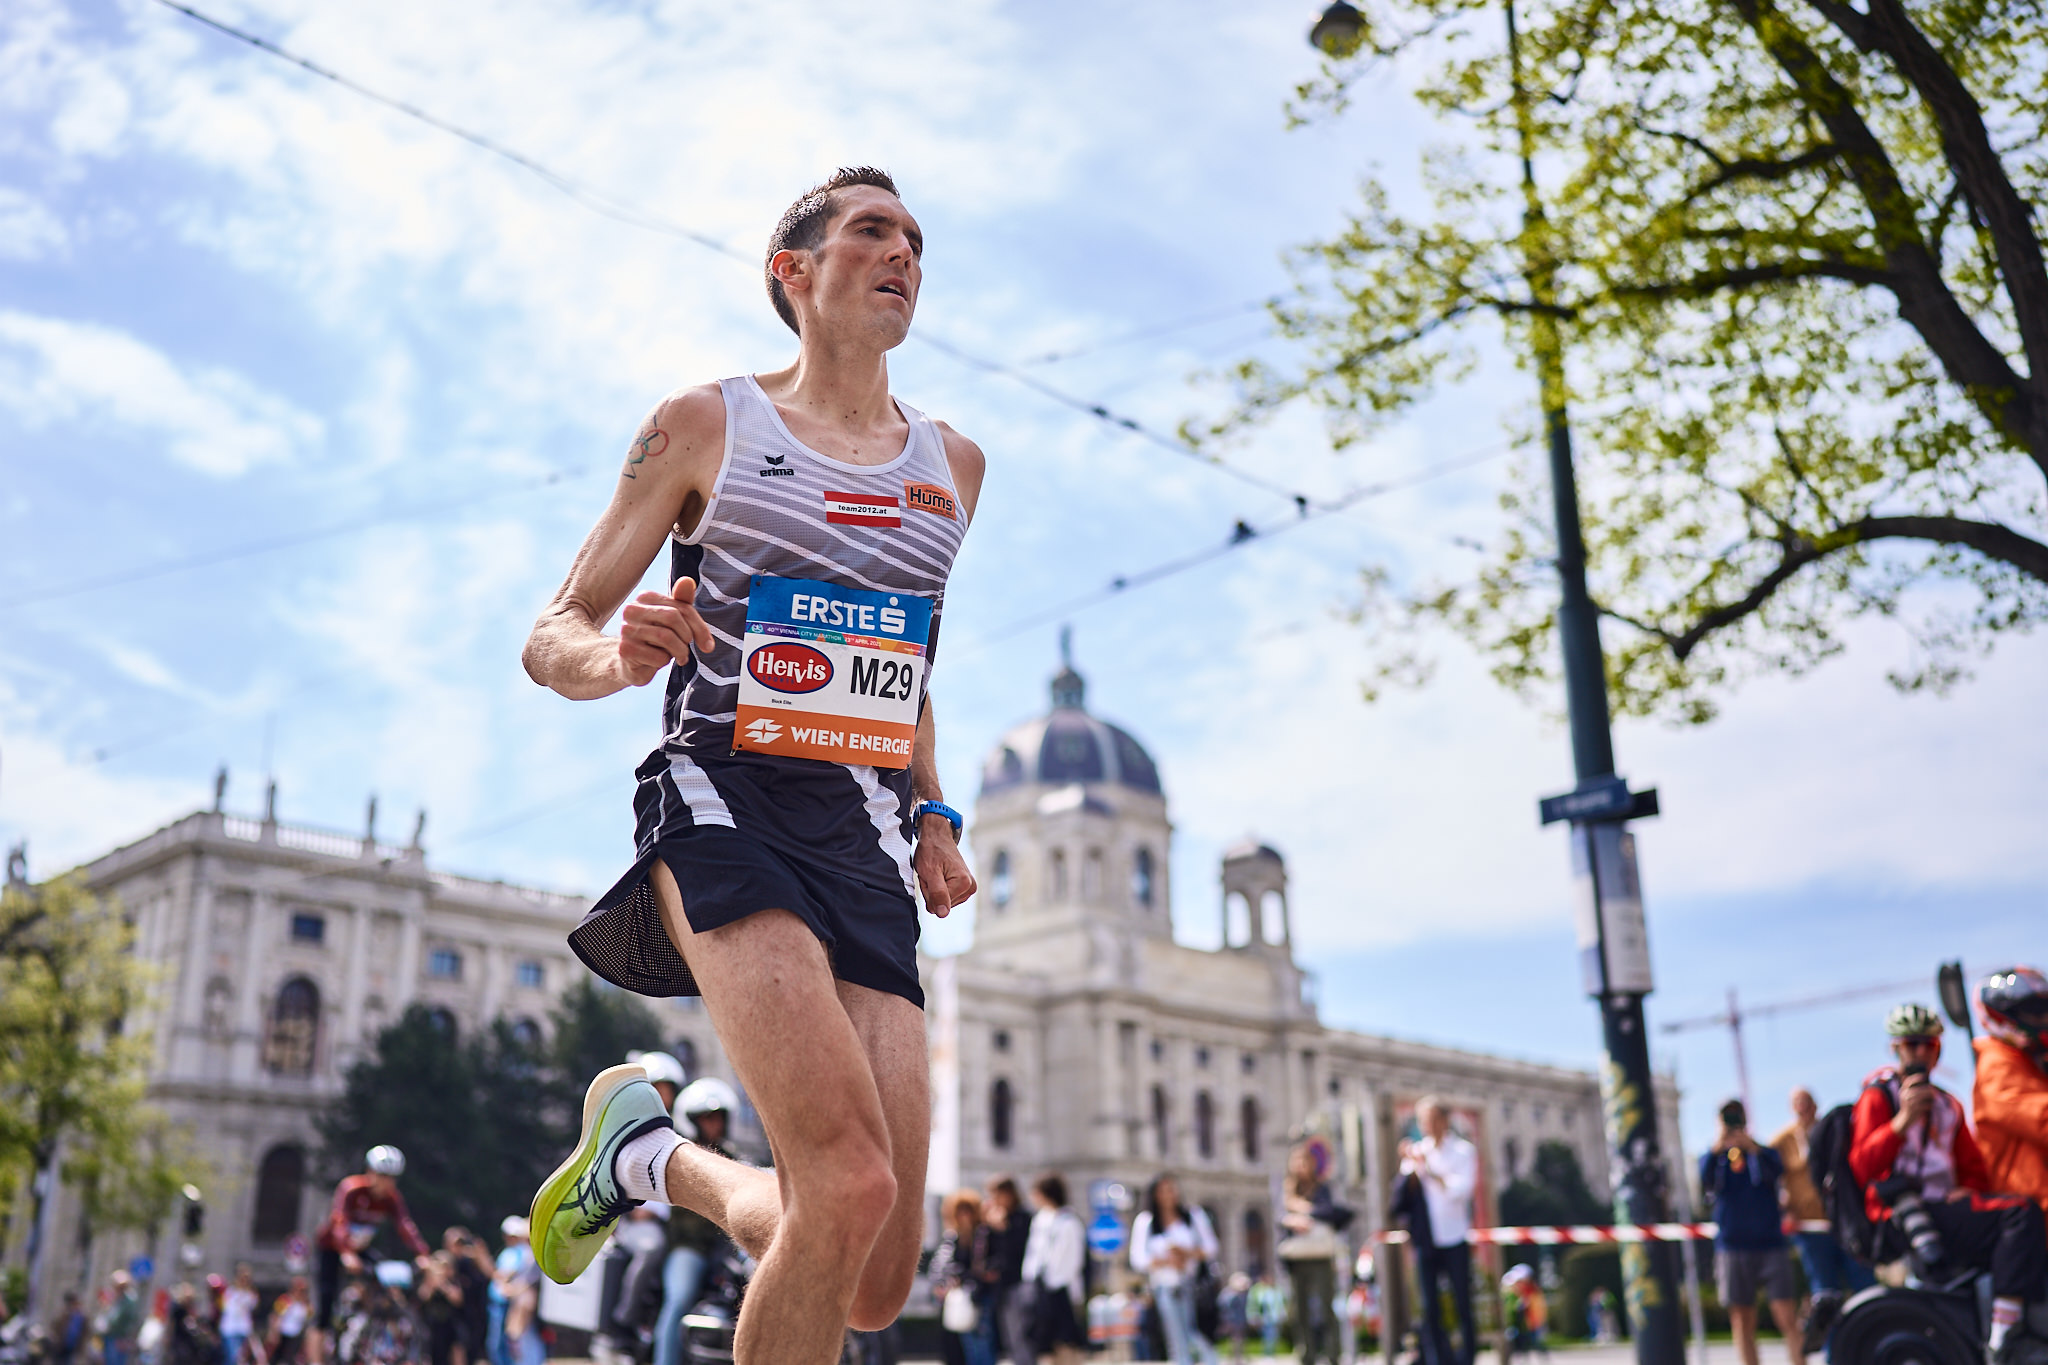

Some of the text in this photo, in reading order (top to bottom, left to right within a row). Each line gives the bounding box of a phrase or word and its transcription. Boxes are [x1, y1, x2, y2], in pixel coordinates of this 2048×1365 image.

[760, 467, 794, 477] erima
[838, 504, 887, 515] team2012.at
[910, 486, 953, 512] Hums
[790, 593, 875, 631] ERSTE
[780, 628, 800, 636] VIENNA
[813, 632, 842, 641] MARATHON
[757, 651, 826, 684] Hervis
[849, 655, 914, 702] M29
[790, 726, 911, 755] WIEN ENERGIE
